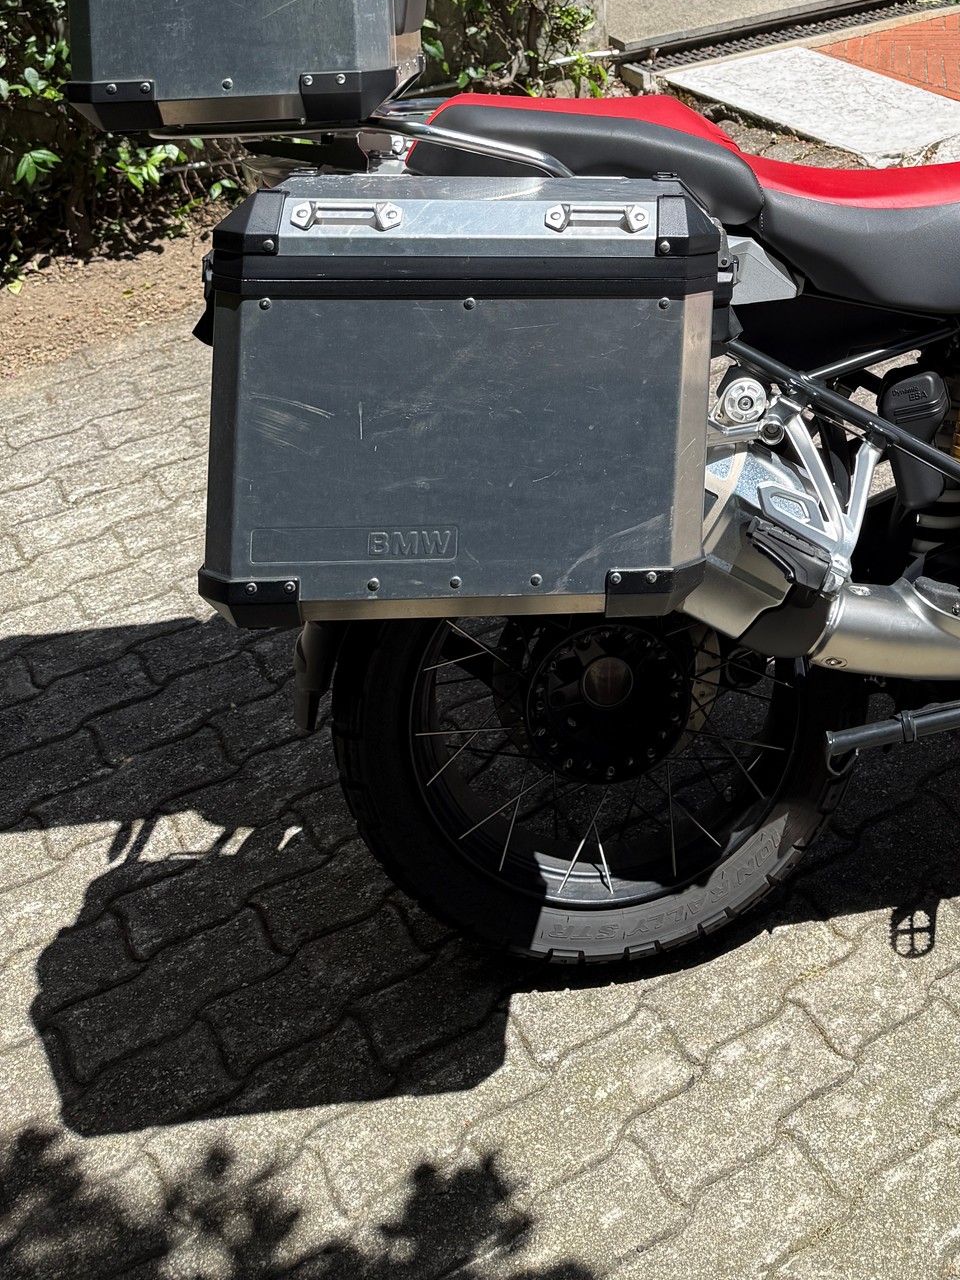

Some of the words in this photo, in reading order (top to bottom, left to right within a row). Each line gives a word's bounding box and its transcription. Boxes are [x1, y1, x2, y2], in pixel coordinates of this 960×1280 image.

[366, 529, 451, 557] BMW
[626, 879, 729, 937] RALLY
[548, 923, 619, 940] STR
